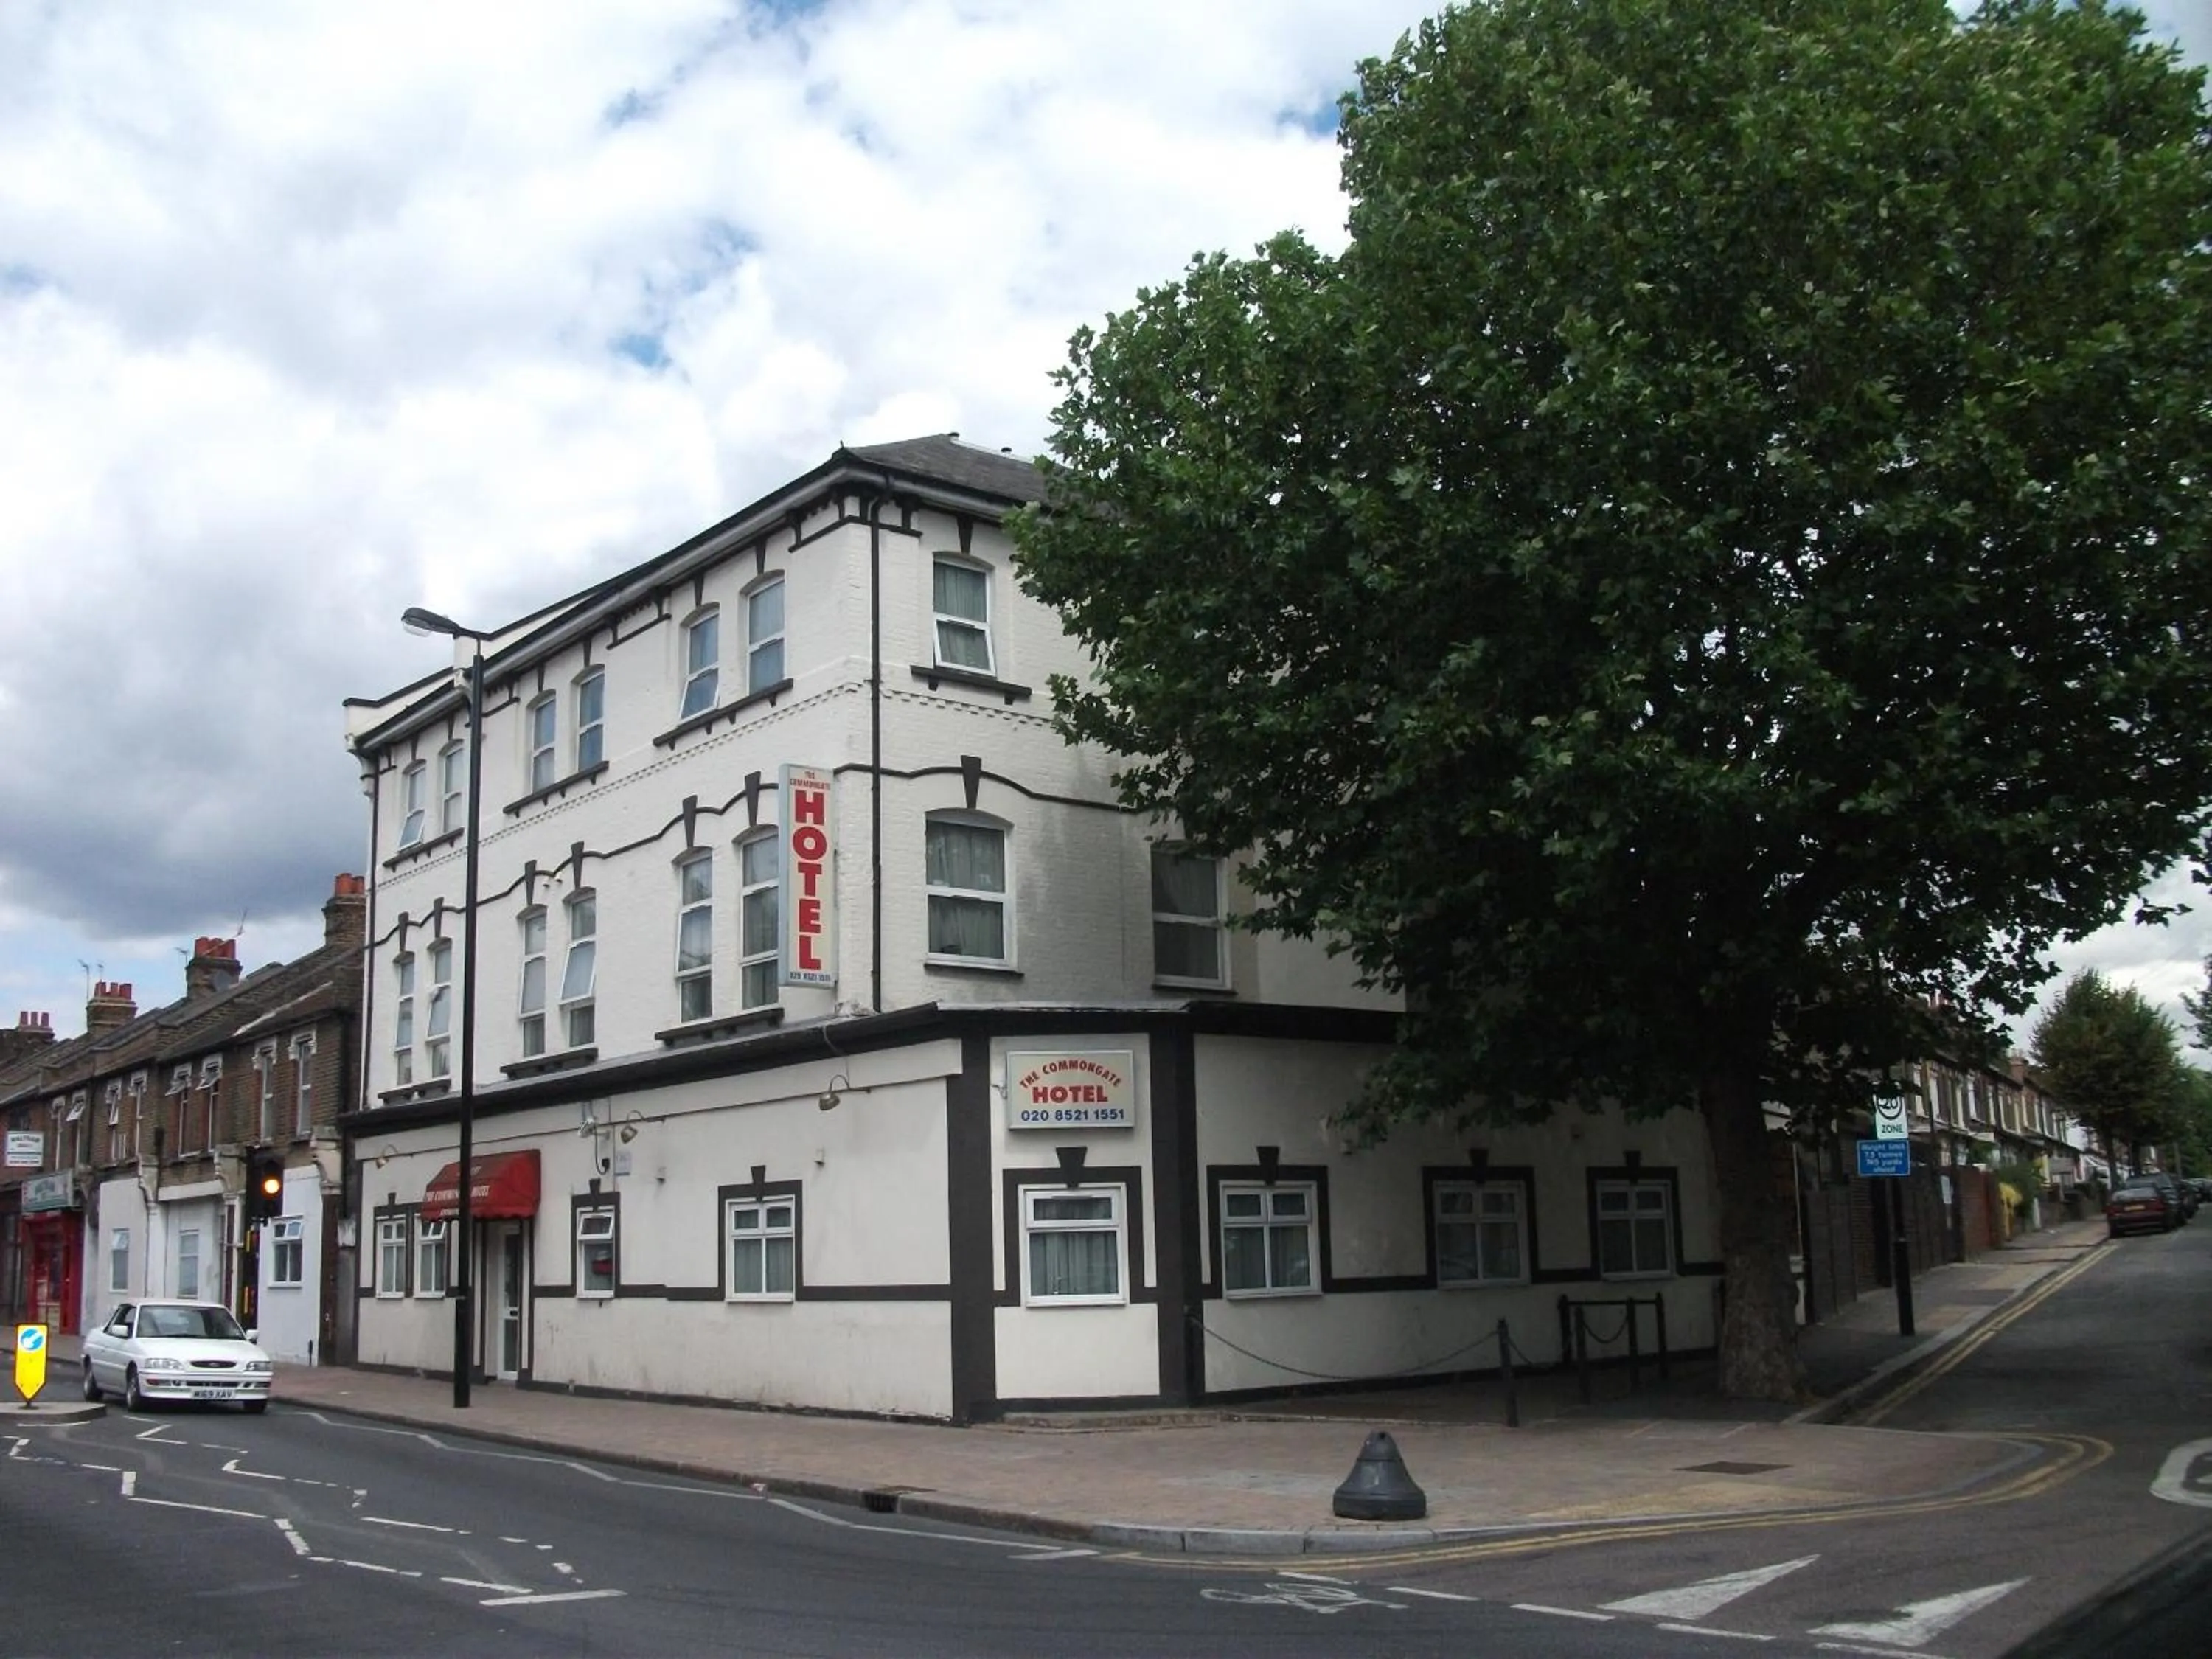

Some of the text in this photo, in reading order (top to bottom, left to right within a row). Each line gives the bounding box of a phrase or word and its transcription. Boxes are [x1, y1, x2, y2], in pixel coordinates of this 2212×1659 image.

[792, 790, 828, 970] HOTEL
[1019, 1060, 1122, 1089] THE COMMONGATE
[1032, 1085, 1108, 1104] HOTEL
[1021, 1108, 1124, 1121] 020 8521 1551
[1881, 1124, 1904, 1133] ZONE
